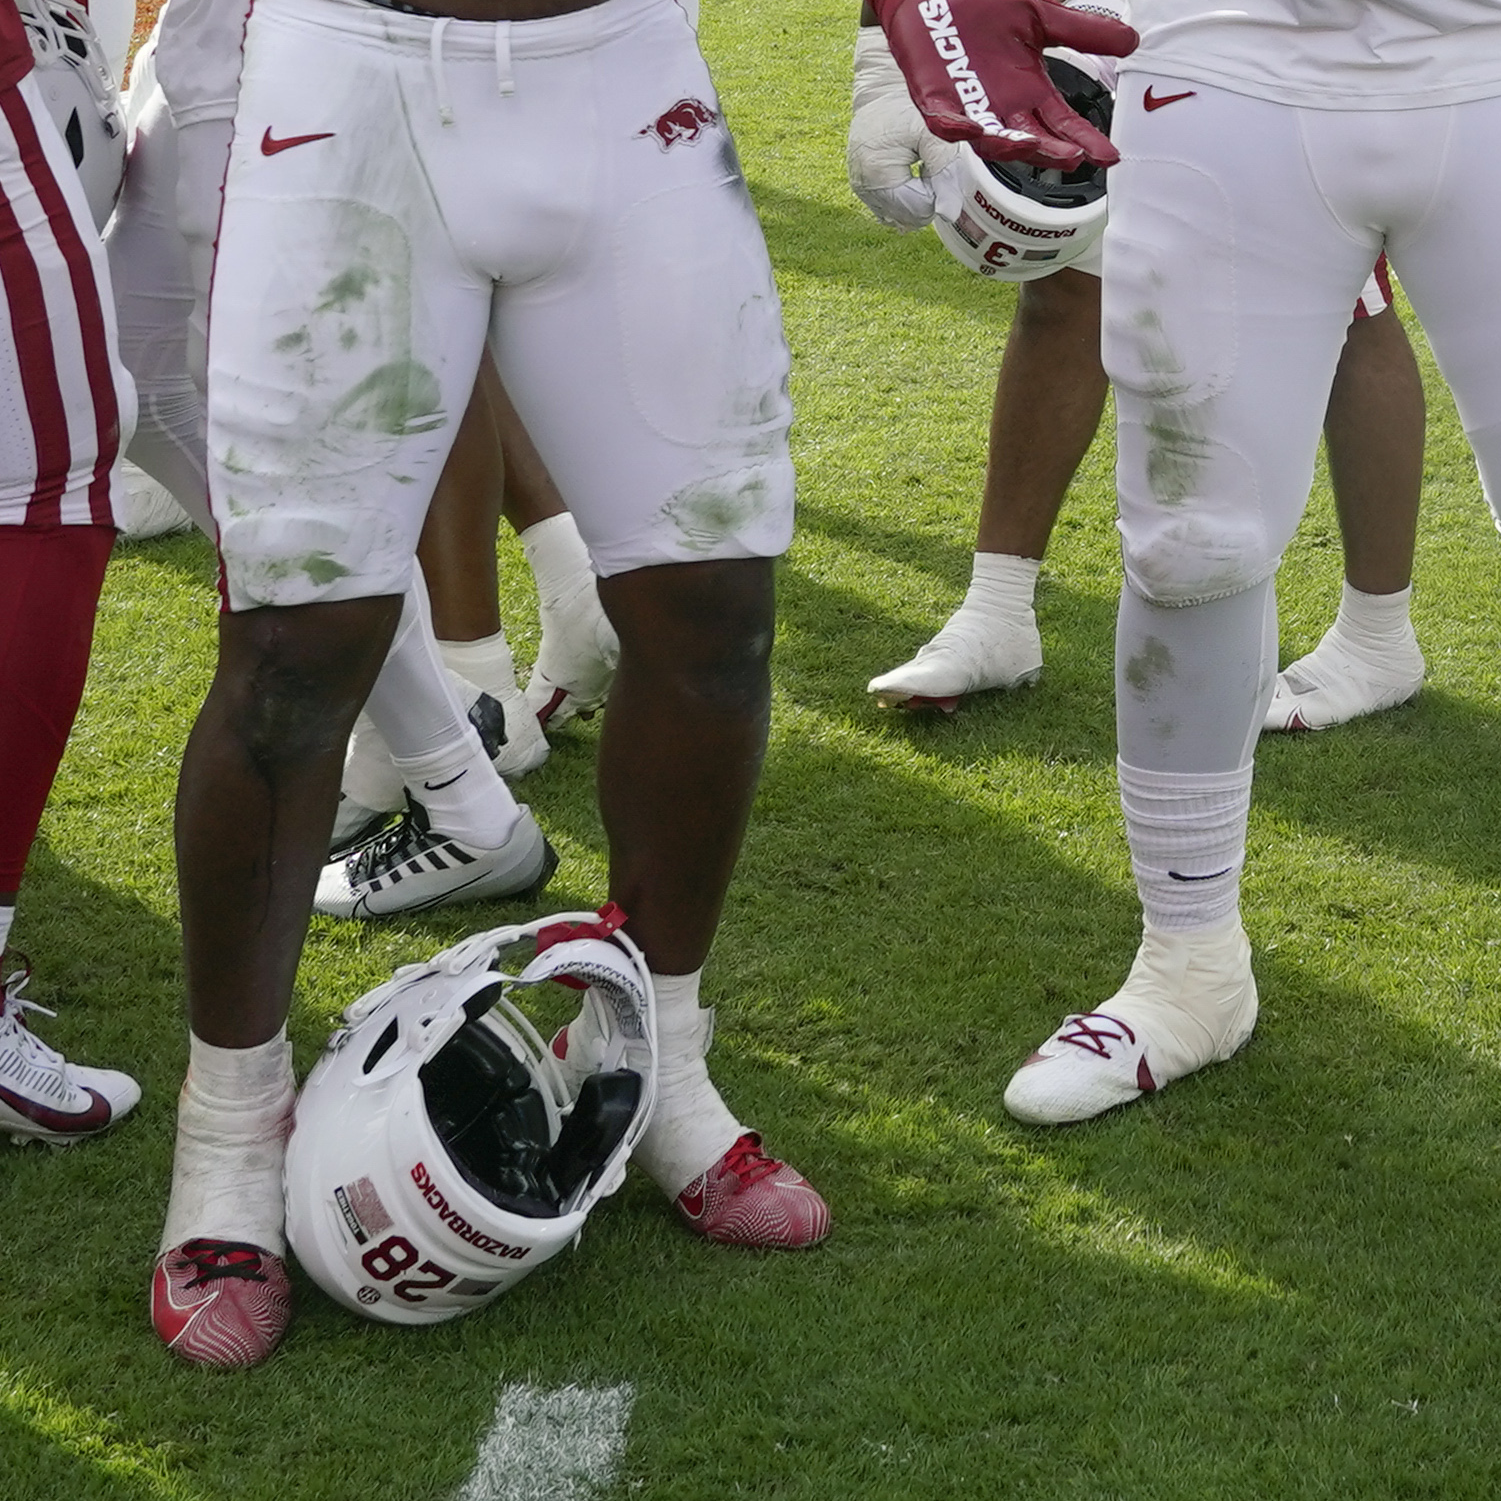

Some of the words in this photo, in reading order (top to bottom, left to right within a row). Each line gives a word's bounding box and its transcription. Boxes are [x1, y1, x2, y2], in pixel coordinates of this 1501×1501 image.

[974, 190, 1077, 238] RAZORBACKS
[410, 1161, 532, 1260] RAZORBACKS
[361, 1234, 458, 1303] 28
